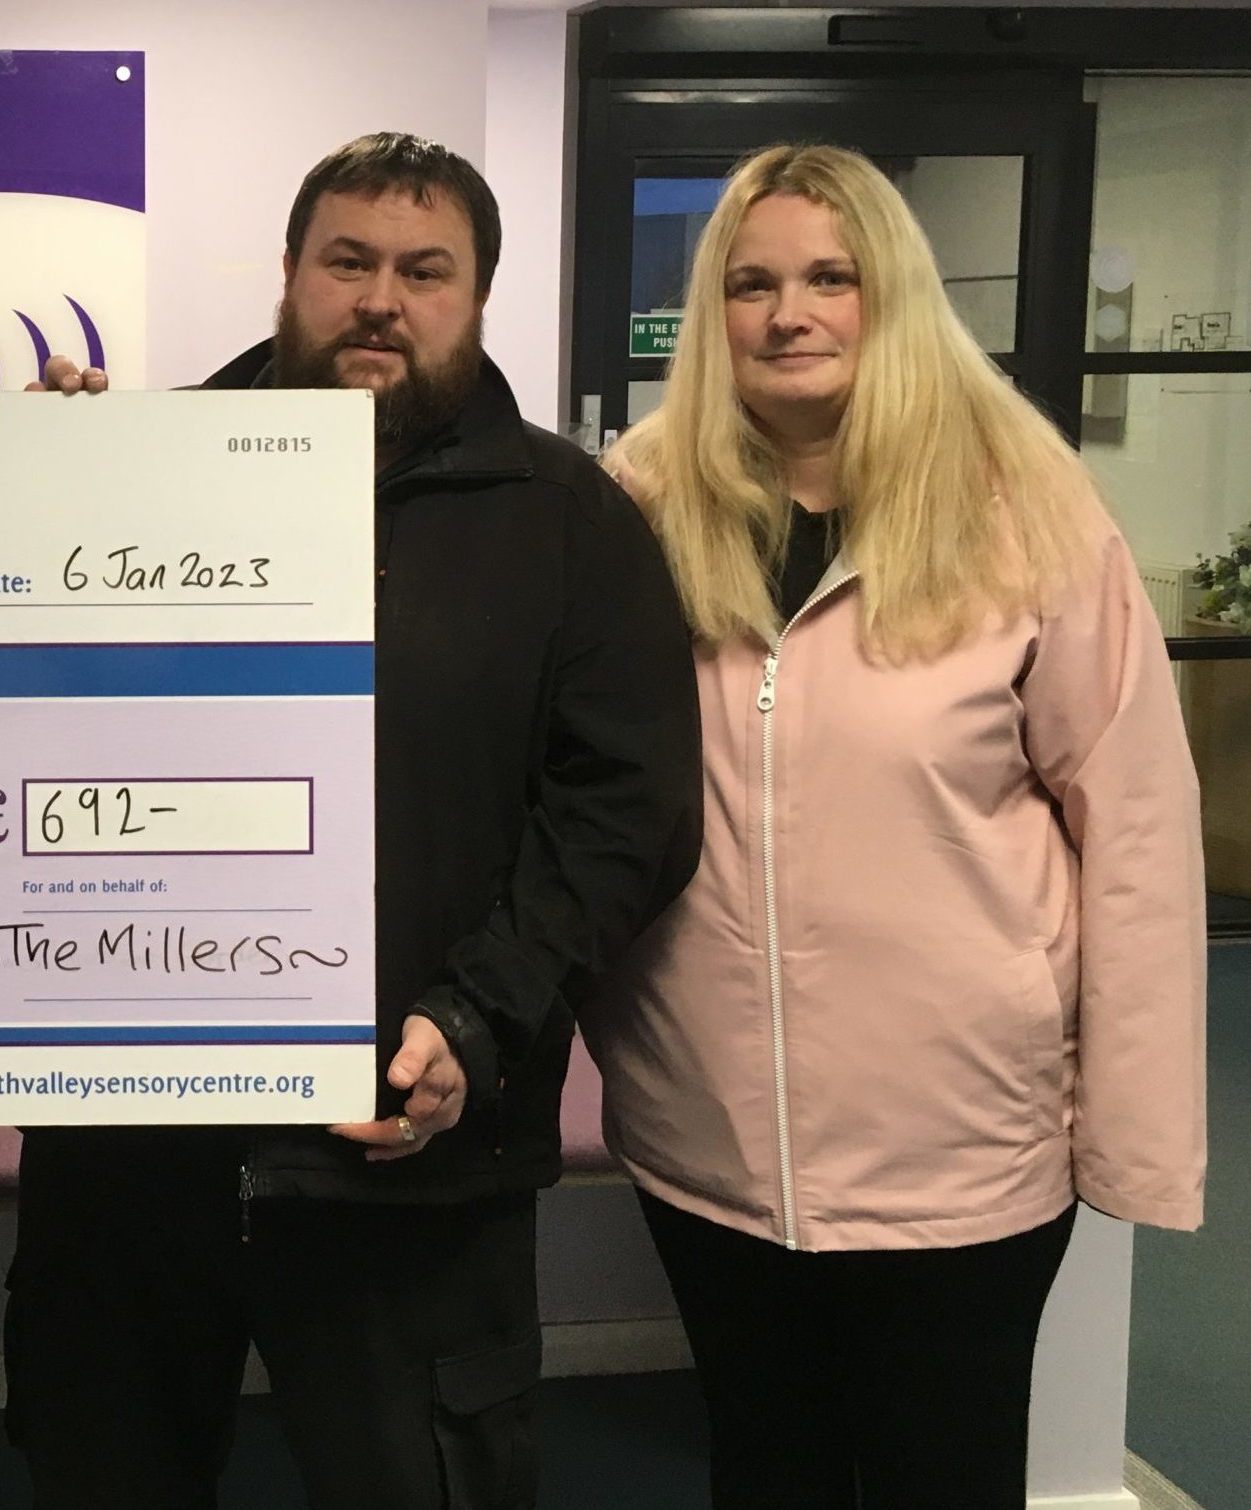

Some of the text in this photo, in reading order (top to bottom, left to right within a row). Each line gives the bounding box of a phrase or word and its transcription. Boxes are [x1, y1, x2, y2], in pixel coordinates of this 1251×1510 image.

[634, 323, 645, 334] IN
[649, 323, 668, 334] THE
[228, 437, 312, 453] 0012815
[63, 545, 271, 591] 6 Jan 2023
[23, 879, 168, 893] For and on behalf of:
